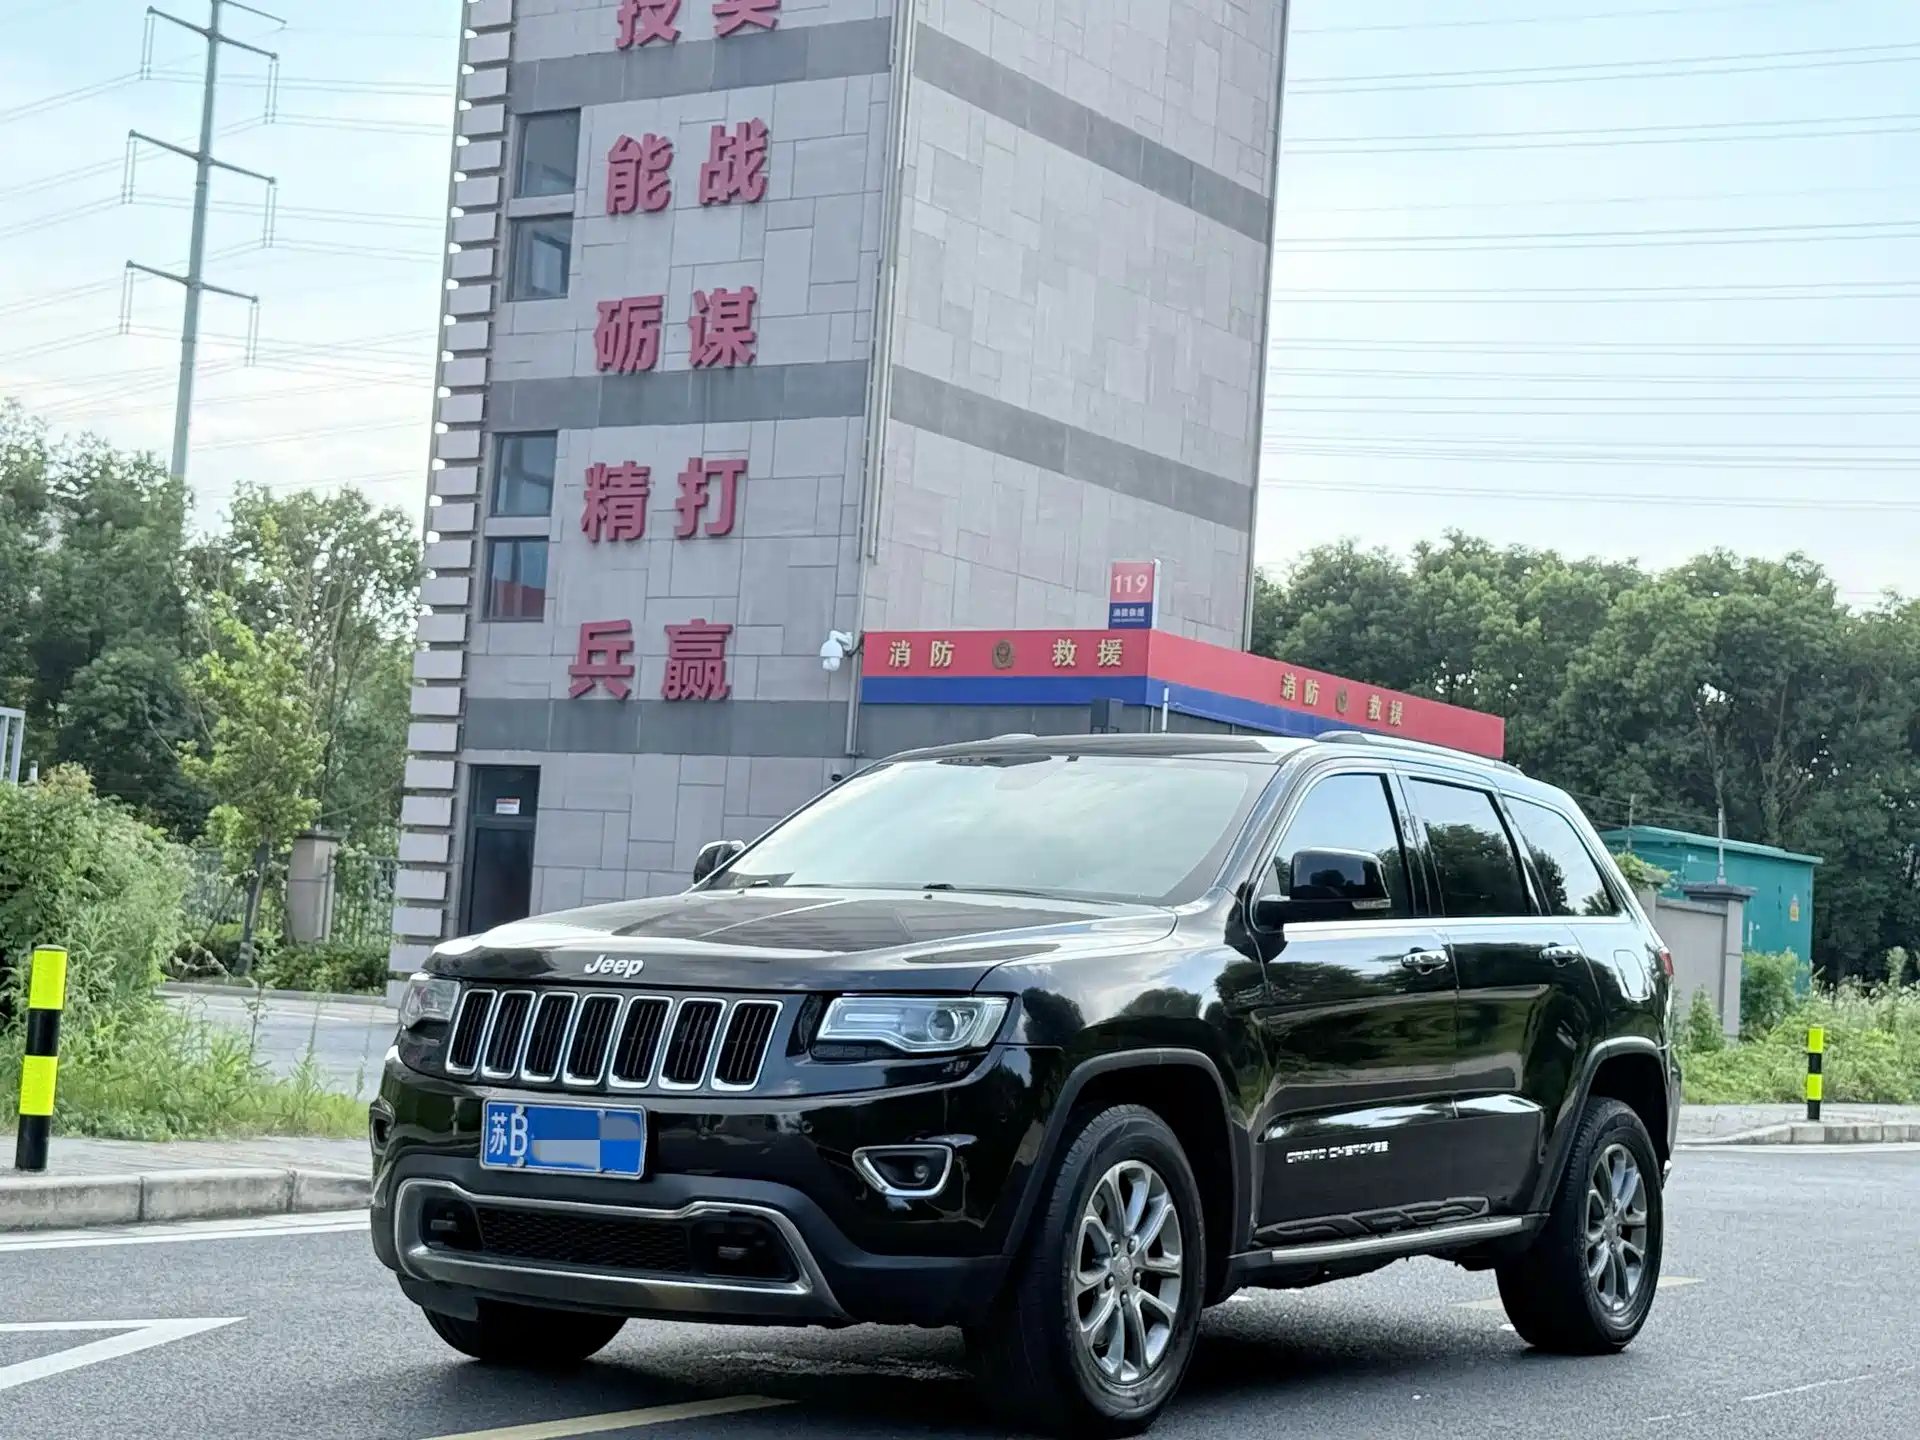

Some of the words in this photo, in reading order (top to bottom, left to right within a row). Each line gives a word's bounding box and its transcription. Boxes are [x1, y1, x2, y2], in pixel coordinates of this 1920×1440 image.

[1114, 574, 1148, 593] 119
[888, 640, 955, 669] 消防
[1052, 638, 1125, 667] 救援
[1280, 671, 1320, 706] 消防
[583, 954, 645, 979] Jeep
[489, 1111, 528, 1157] 苏B
